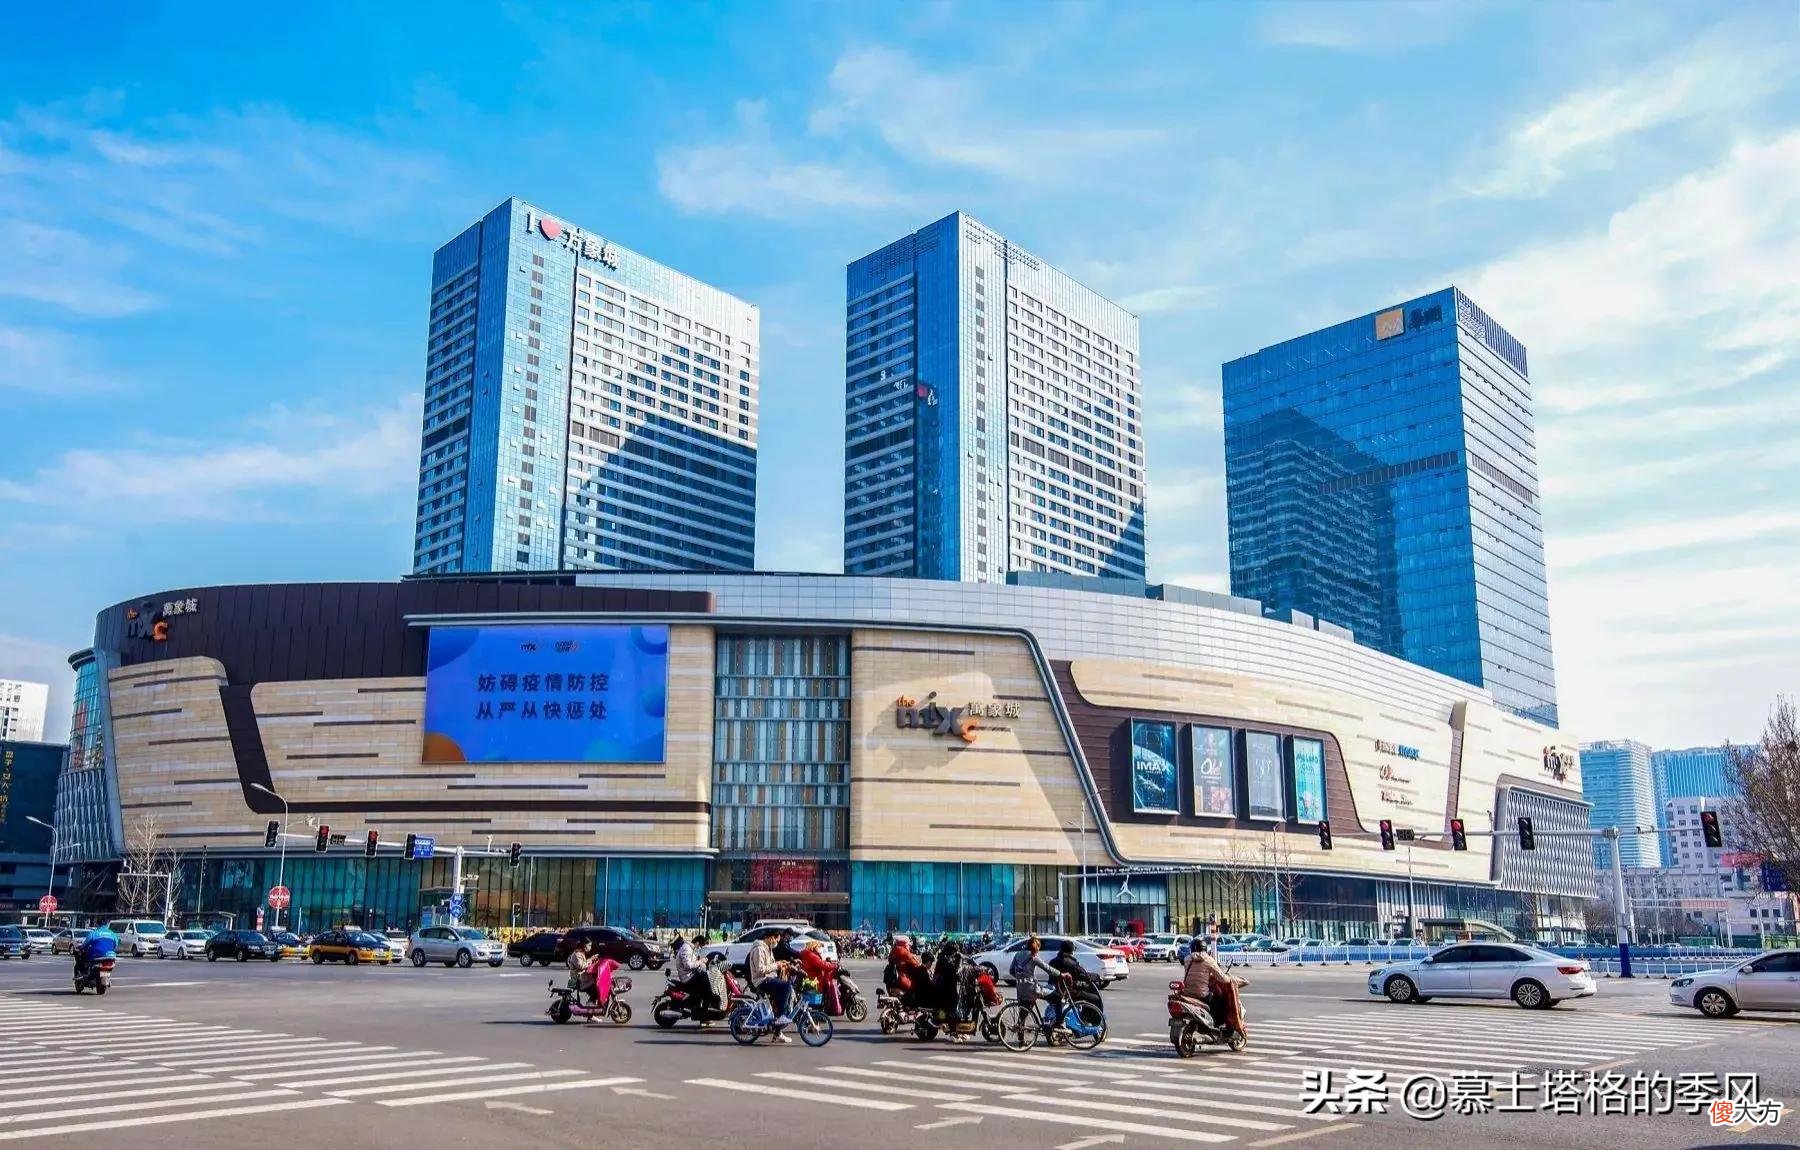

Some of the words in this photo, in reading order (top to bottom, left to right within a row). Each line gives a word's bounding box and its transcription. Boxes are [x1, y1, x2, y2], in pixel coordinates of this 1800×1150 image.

[478, 673, 610, 692] 妨碍疫情防控
[475, 701, 608, 720] 从严从快惩处
[1136, 760, 1171, 773] IMAX
